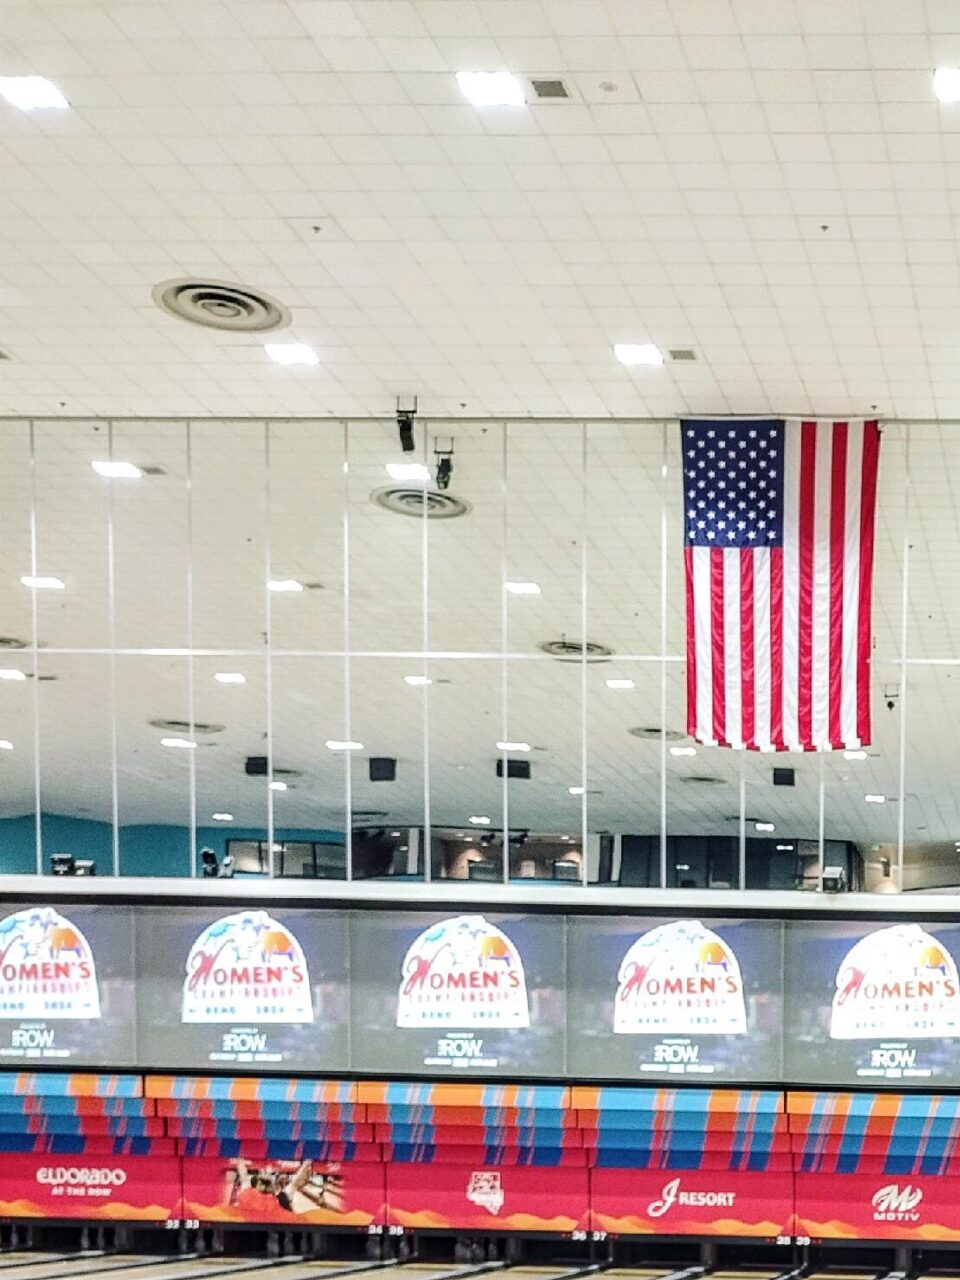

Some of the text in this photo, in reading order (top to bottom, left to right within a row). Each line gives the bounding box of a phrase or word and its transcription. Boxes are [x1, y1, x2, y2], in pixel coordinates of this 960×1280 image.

[0, 938, 91, 981] OMEN'S
[188, 938, 304, 991] WOMEN'S
[403, 943, 520, 995] WOMEN'S
[621, 955, 738, 1001] WOMEN'S
[679, 1191, 736, 1207] RESORT
[873, 1212, 920, 1221] MOTIV
